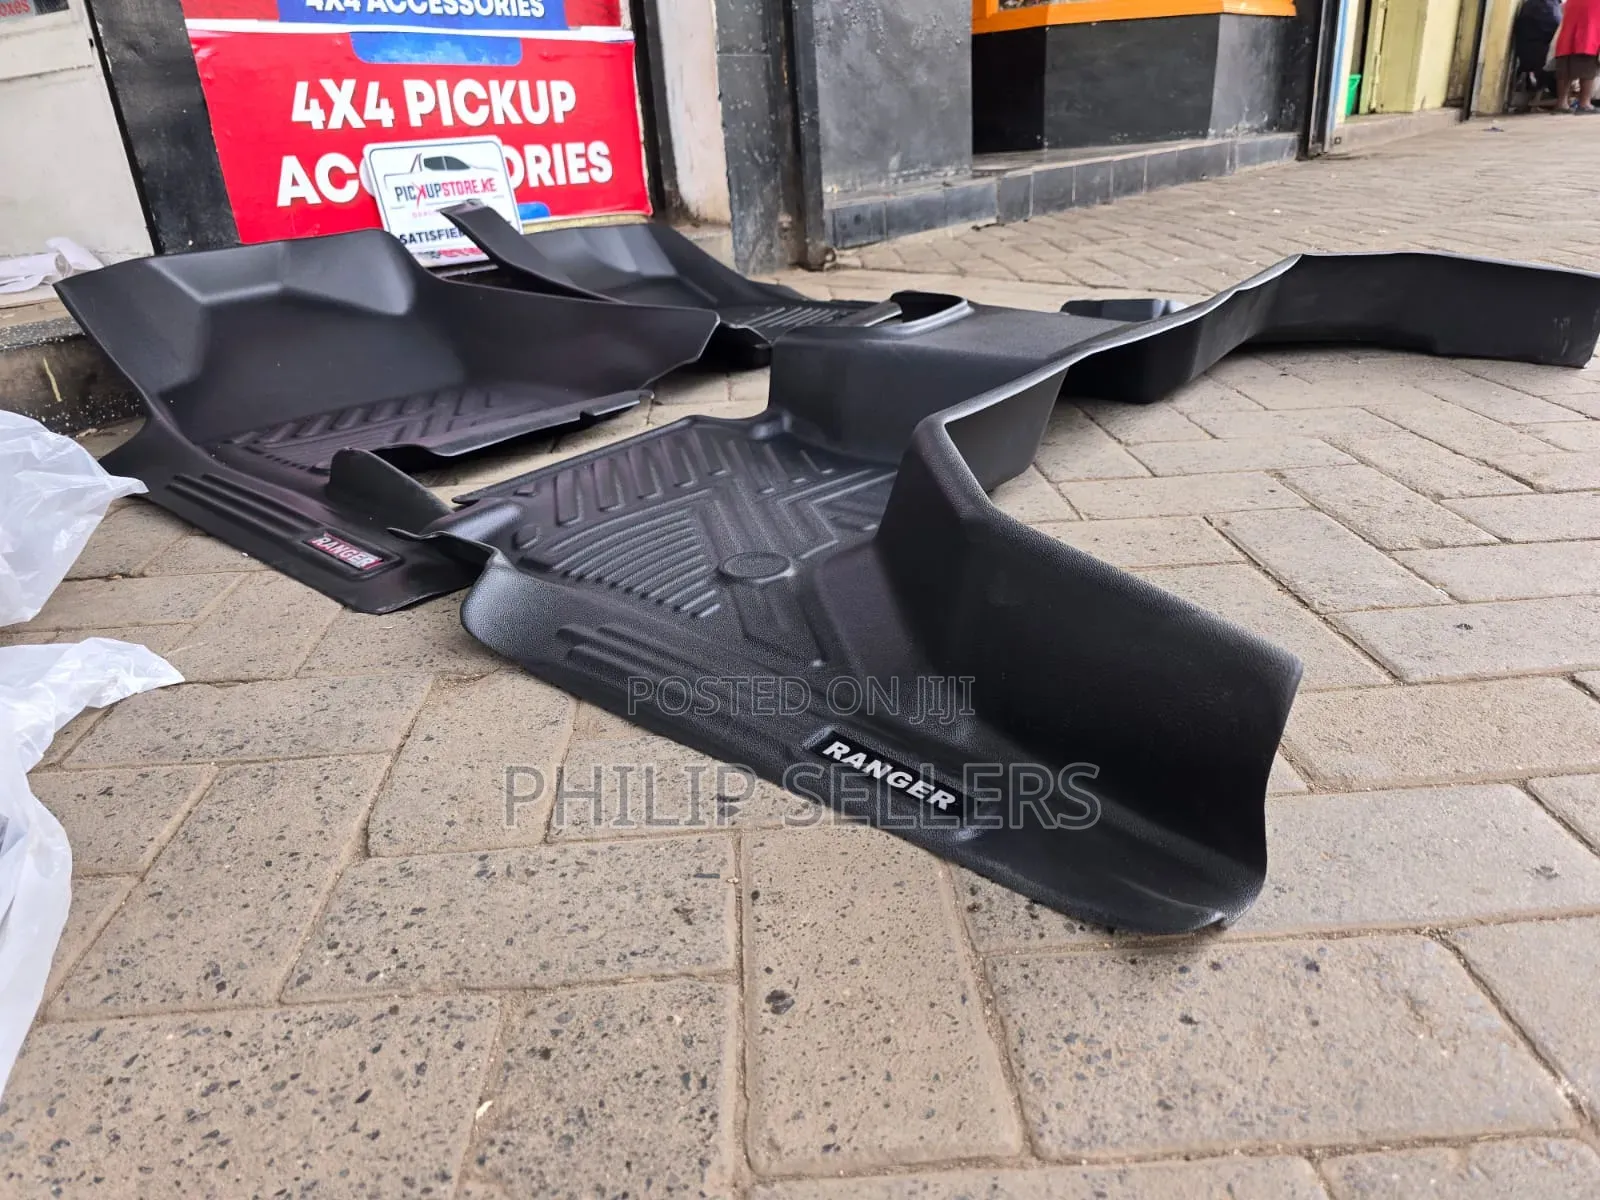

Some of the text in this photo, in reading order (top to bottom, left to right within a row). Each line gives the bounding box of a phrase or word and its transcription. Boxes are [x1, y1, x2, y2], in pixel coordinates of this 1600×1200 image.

[291, 79, 577, 130] 4X4 PICKUP
[277, 141, 613, 207] ACRIES
[311, 534, 383, 569] RANGER
[822, 740, 957, 811] RANGER
